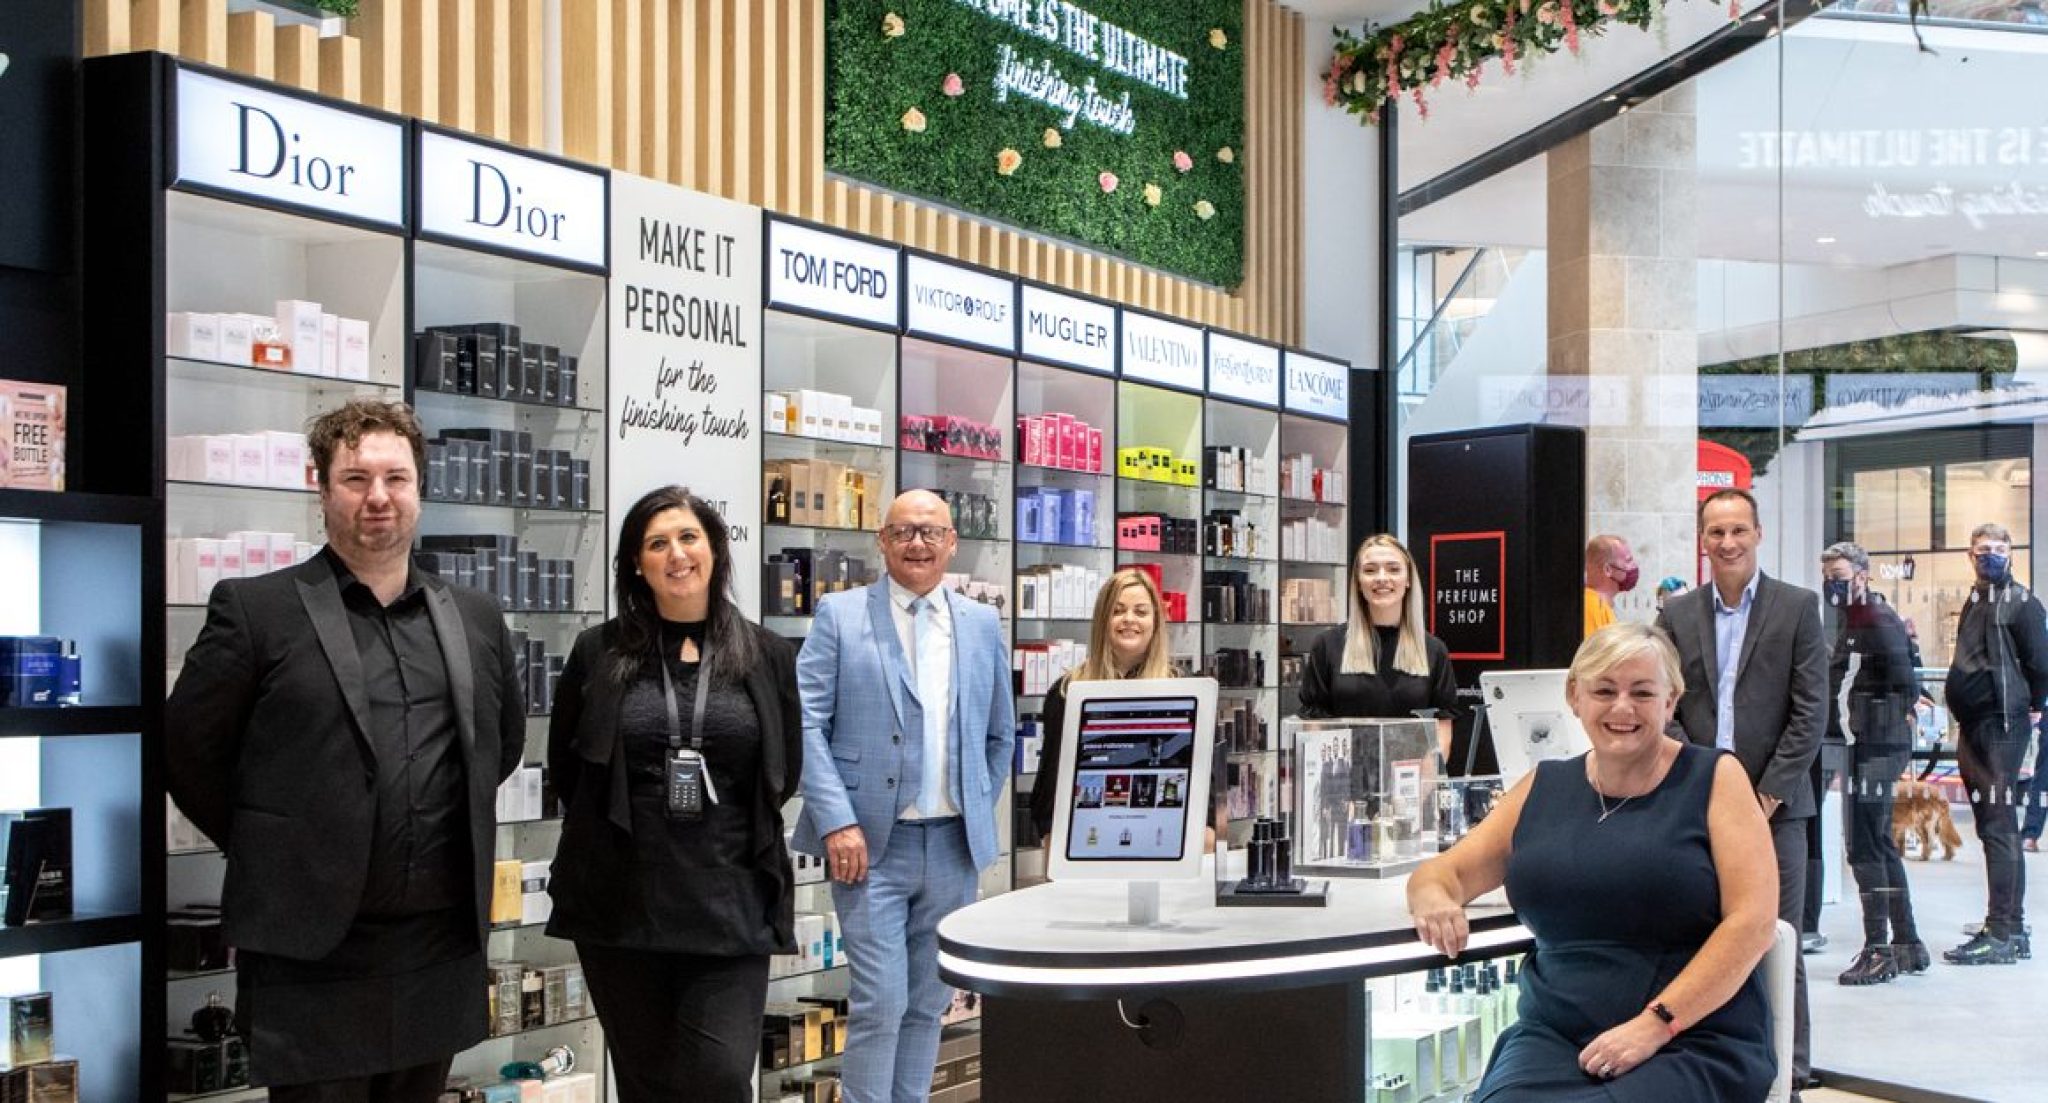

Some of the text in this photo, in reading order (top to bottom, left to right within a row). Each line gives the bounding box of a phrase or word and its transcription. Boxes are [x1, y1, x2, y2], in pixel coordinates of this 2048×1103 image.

[1061, 2, 1099, 61] THE
[1101, 20, 1188, 100] ULTIMATE
[993, 44, 1136, 135] finishing touch
[229, 102, 355, 196] Dior
[465, 159, 566, 241] Dior
[639, 216, 735, 278] MAKE IT
[780, 248, 887, 299] TOM FORD
[625, 284, 747, 348] PERSONAL
[1028, 309, 1108, 349] MUGLER
[1129, 331, 1198, 368] VALENTINO
[655, 356, 718, 399] for the
[13, 422, 48, 445] FREE
[619, 395, 749, 446] finishing touch
[1436, 588, 1498, 604] PERFUME
[1454, 568, 1481, 583] THE
[1448, 608, 1486, 624] SHOP
